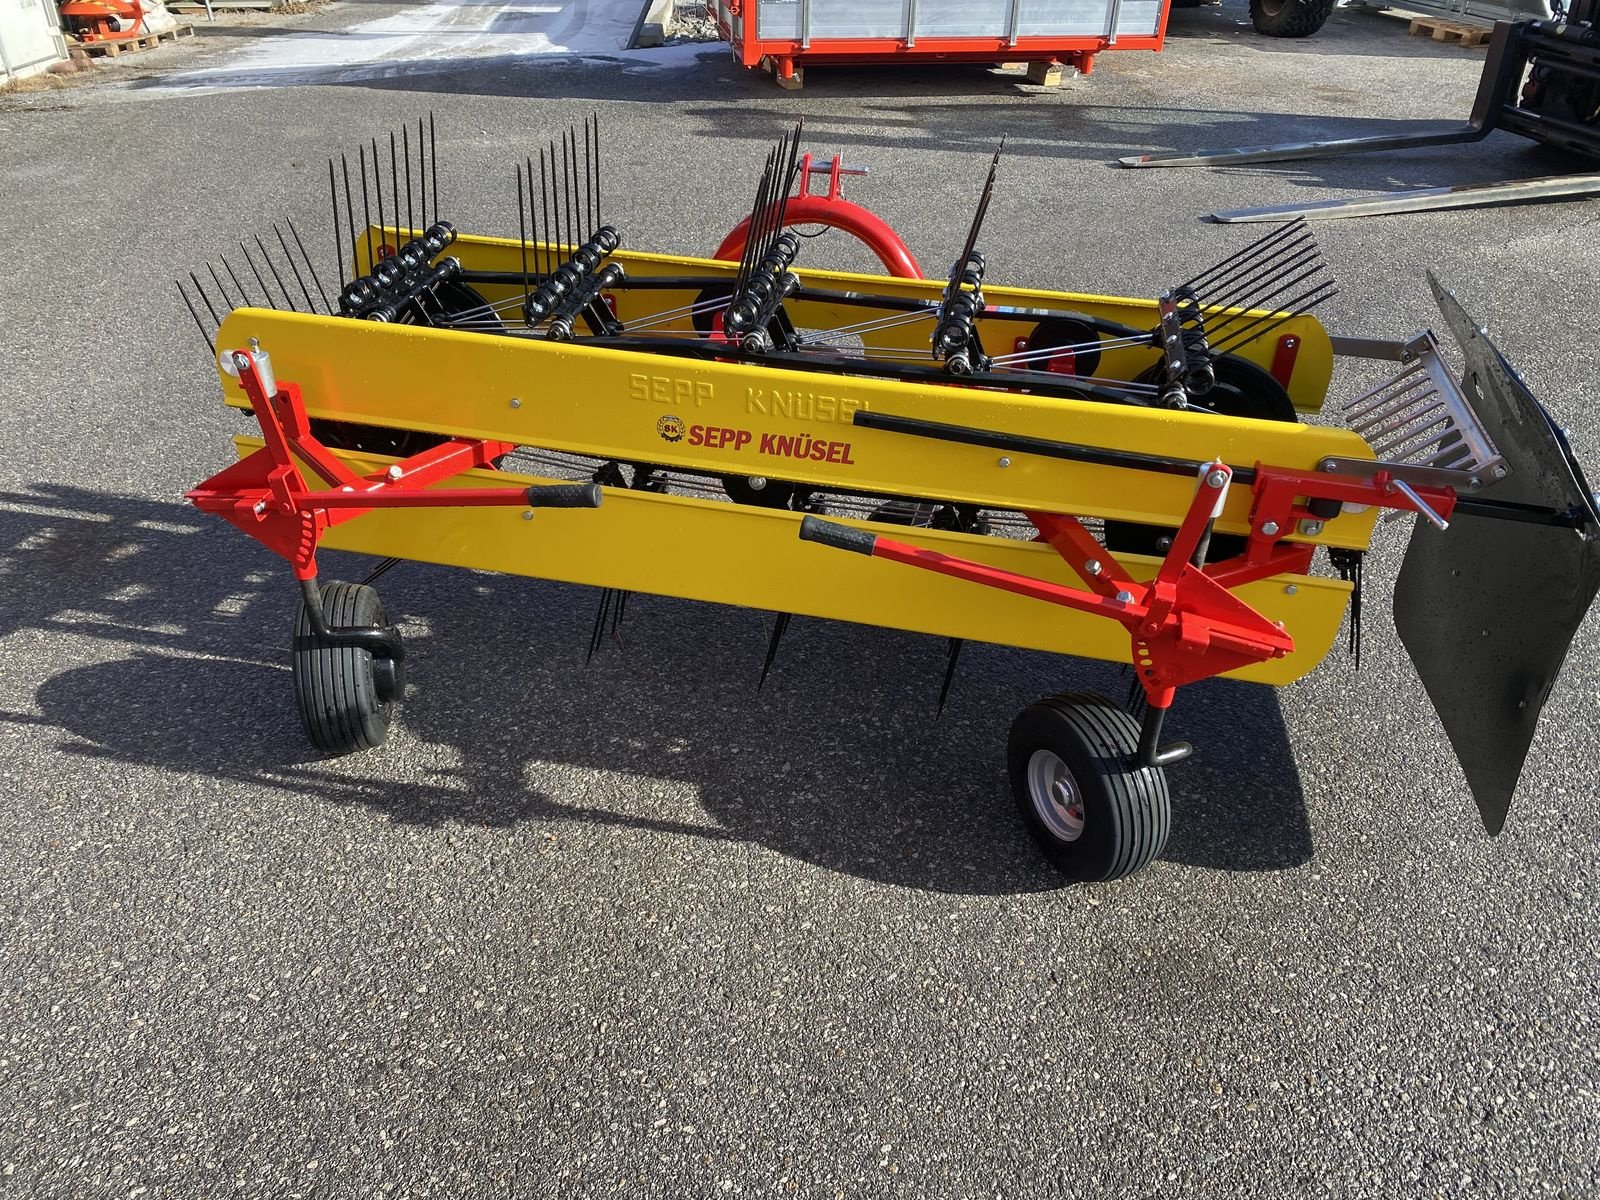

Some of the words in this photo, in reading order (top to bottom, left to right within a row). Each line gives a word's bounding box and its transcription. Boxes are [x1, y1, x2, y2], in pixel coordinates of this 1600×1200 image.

[630, 373, 714, 407] SEPP
[687, 424, 752, 451] SEPP
[759, 432, 855, 465] KNÜSEL
